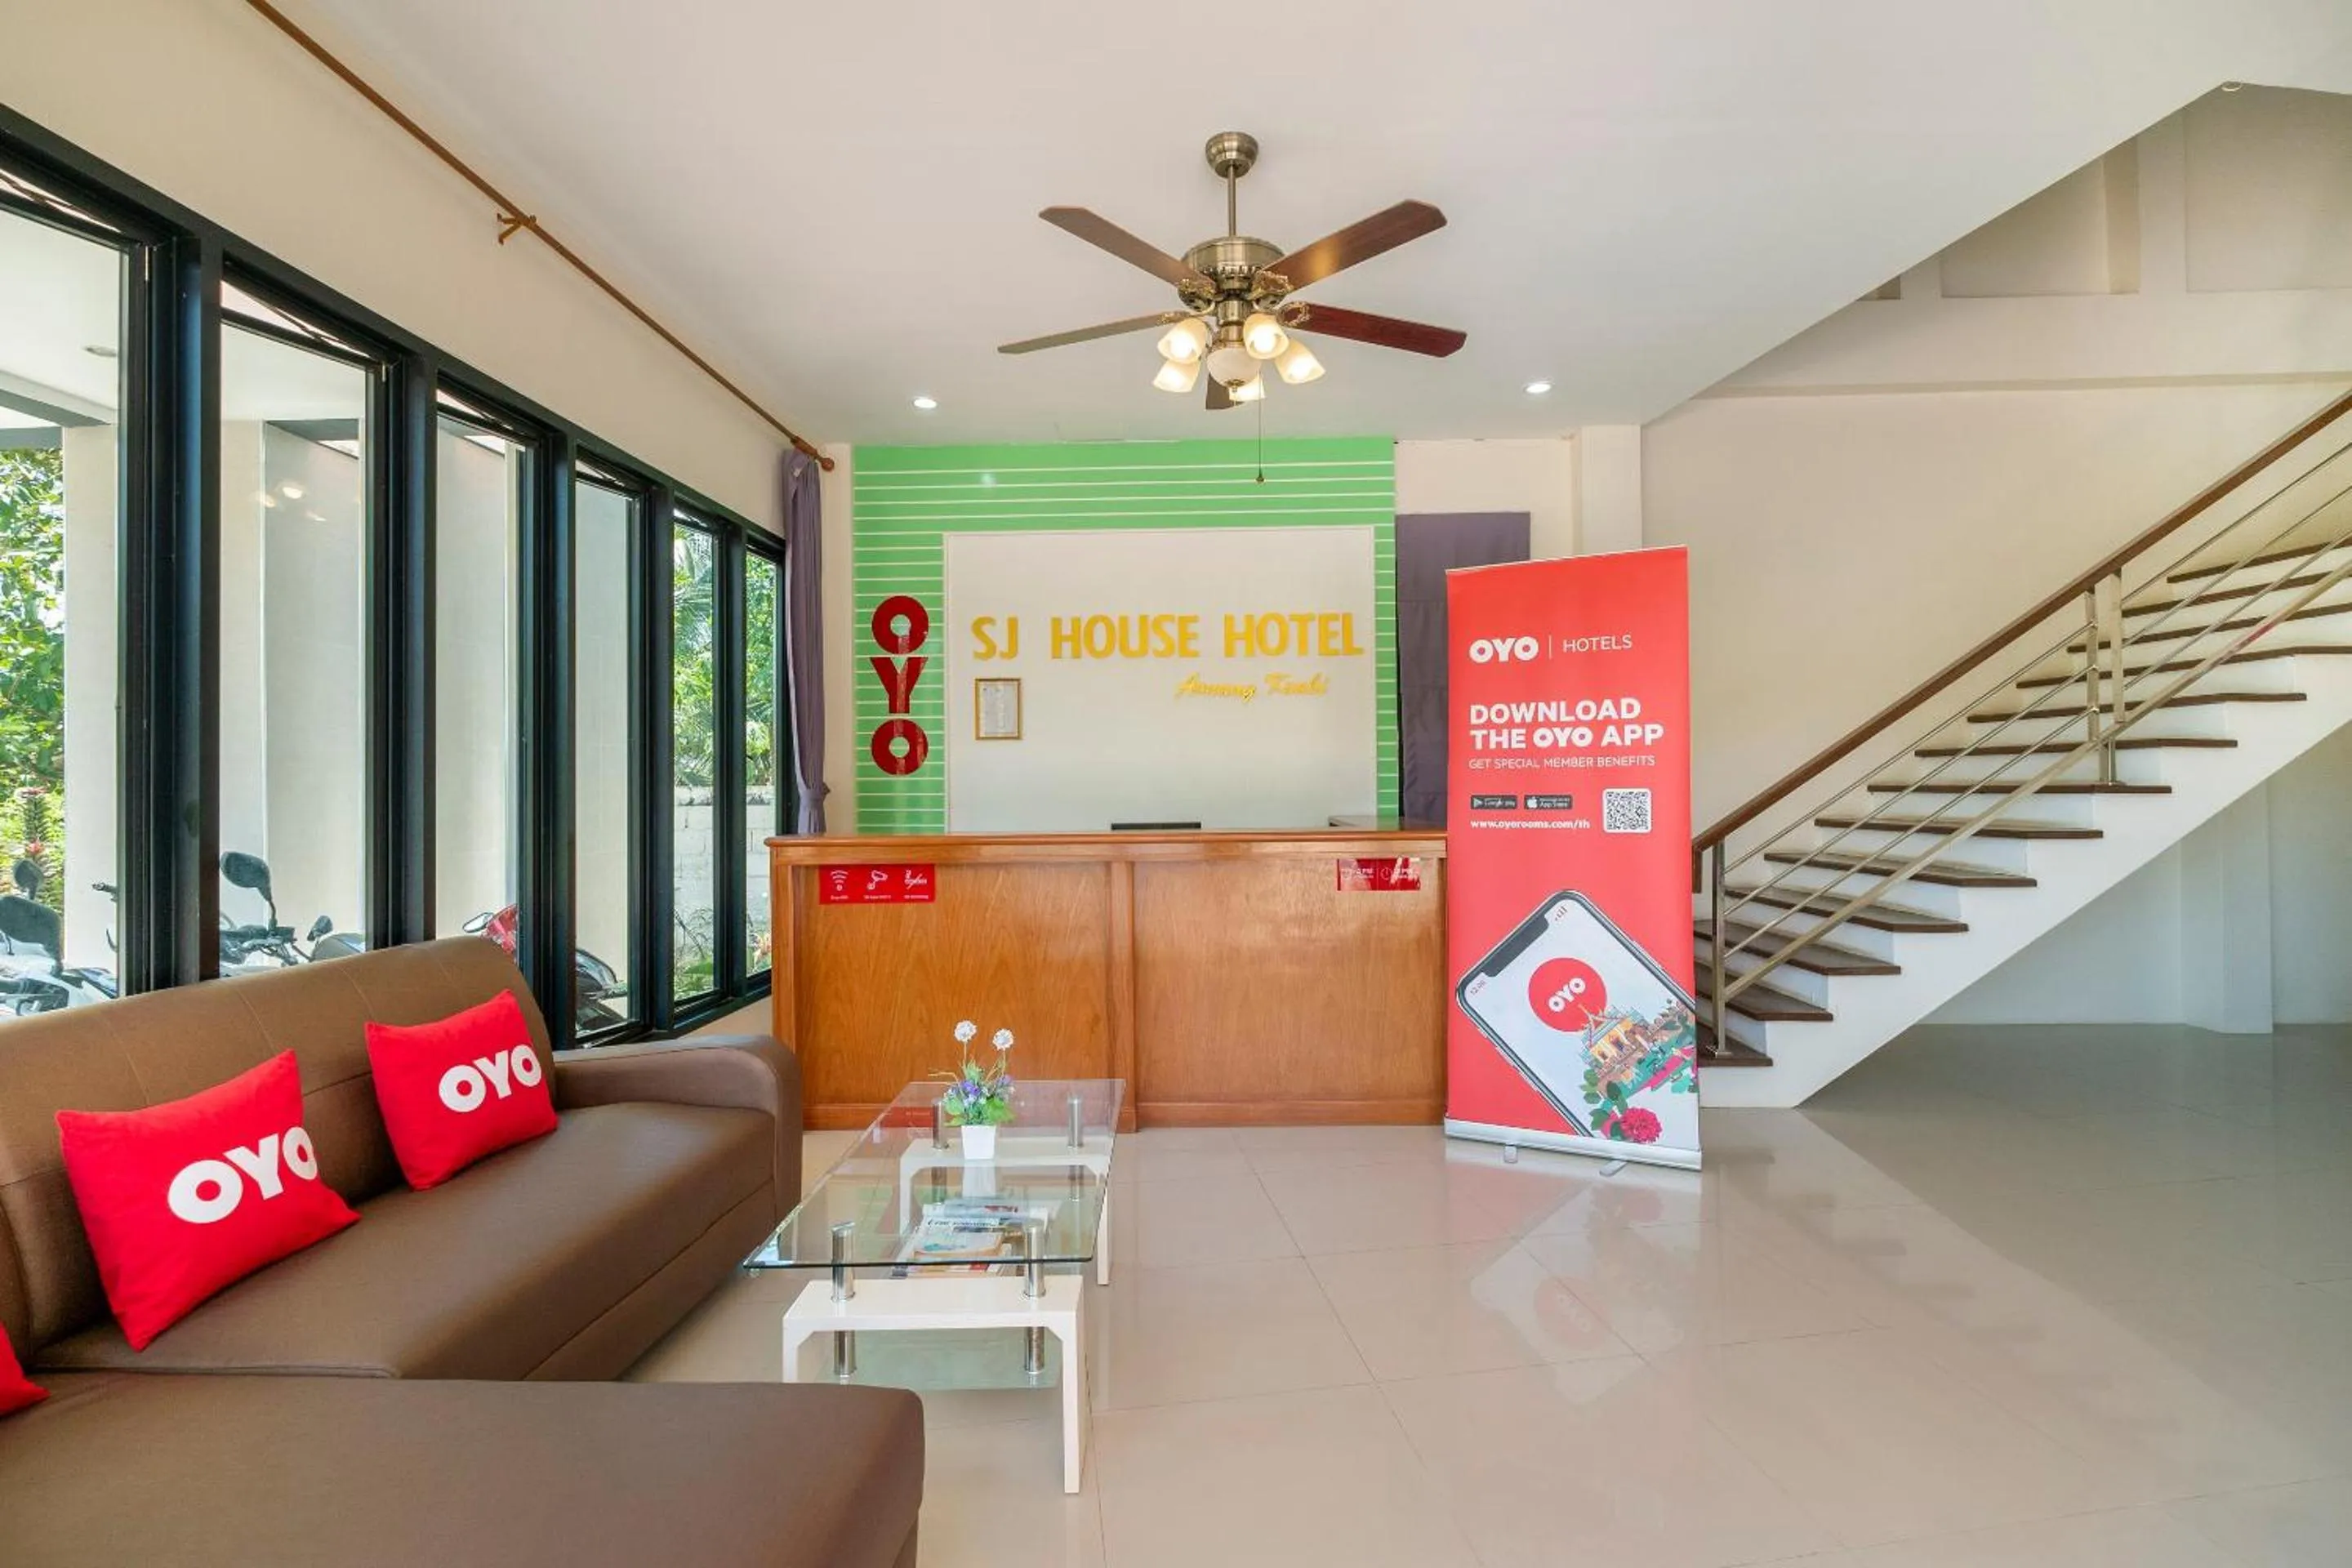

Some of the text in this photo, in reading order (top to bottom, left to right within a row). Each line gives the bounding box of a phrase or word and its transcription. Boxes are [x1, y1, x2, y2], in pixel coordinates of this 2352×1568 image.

[970, 612, 1365, 661] SJ HOUSE HOTEL
[1468, 635, 1633, 663] OYO HOTELS
[870, 595, 929, 776] OYO
[1469, 697, 1642, 725] DOWNLOAD
[1469, 723, 1664, 751] THE OYO APP
[1468, 755, 1656, 769] GET SPECIAL MEMBER BENEFITS
[1470, 818, 1591, 830] www.oyorooms.com/th
[1548, 978, 1586, 1013] OYO
[438, 1044, 542, 1113] OYO
[167, 1125, 318, 1224] OYO
